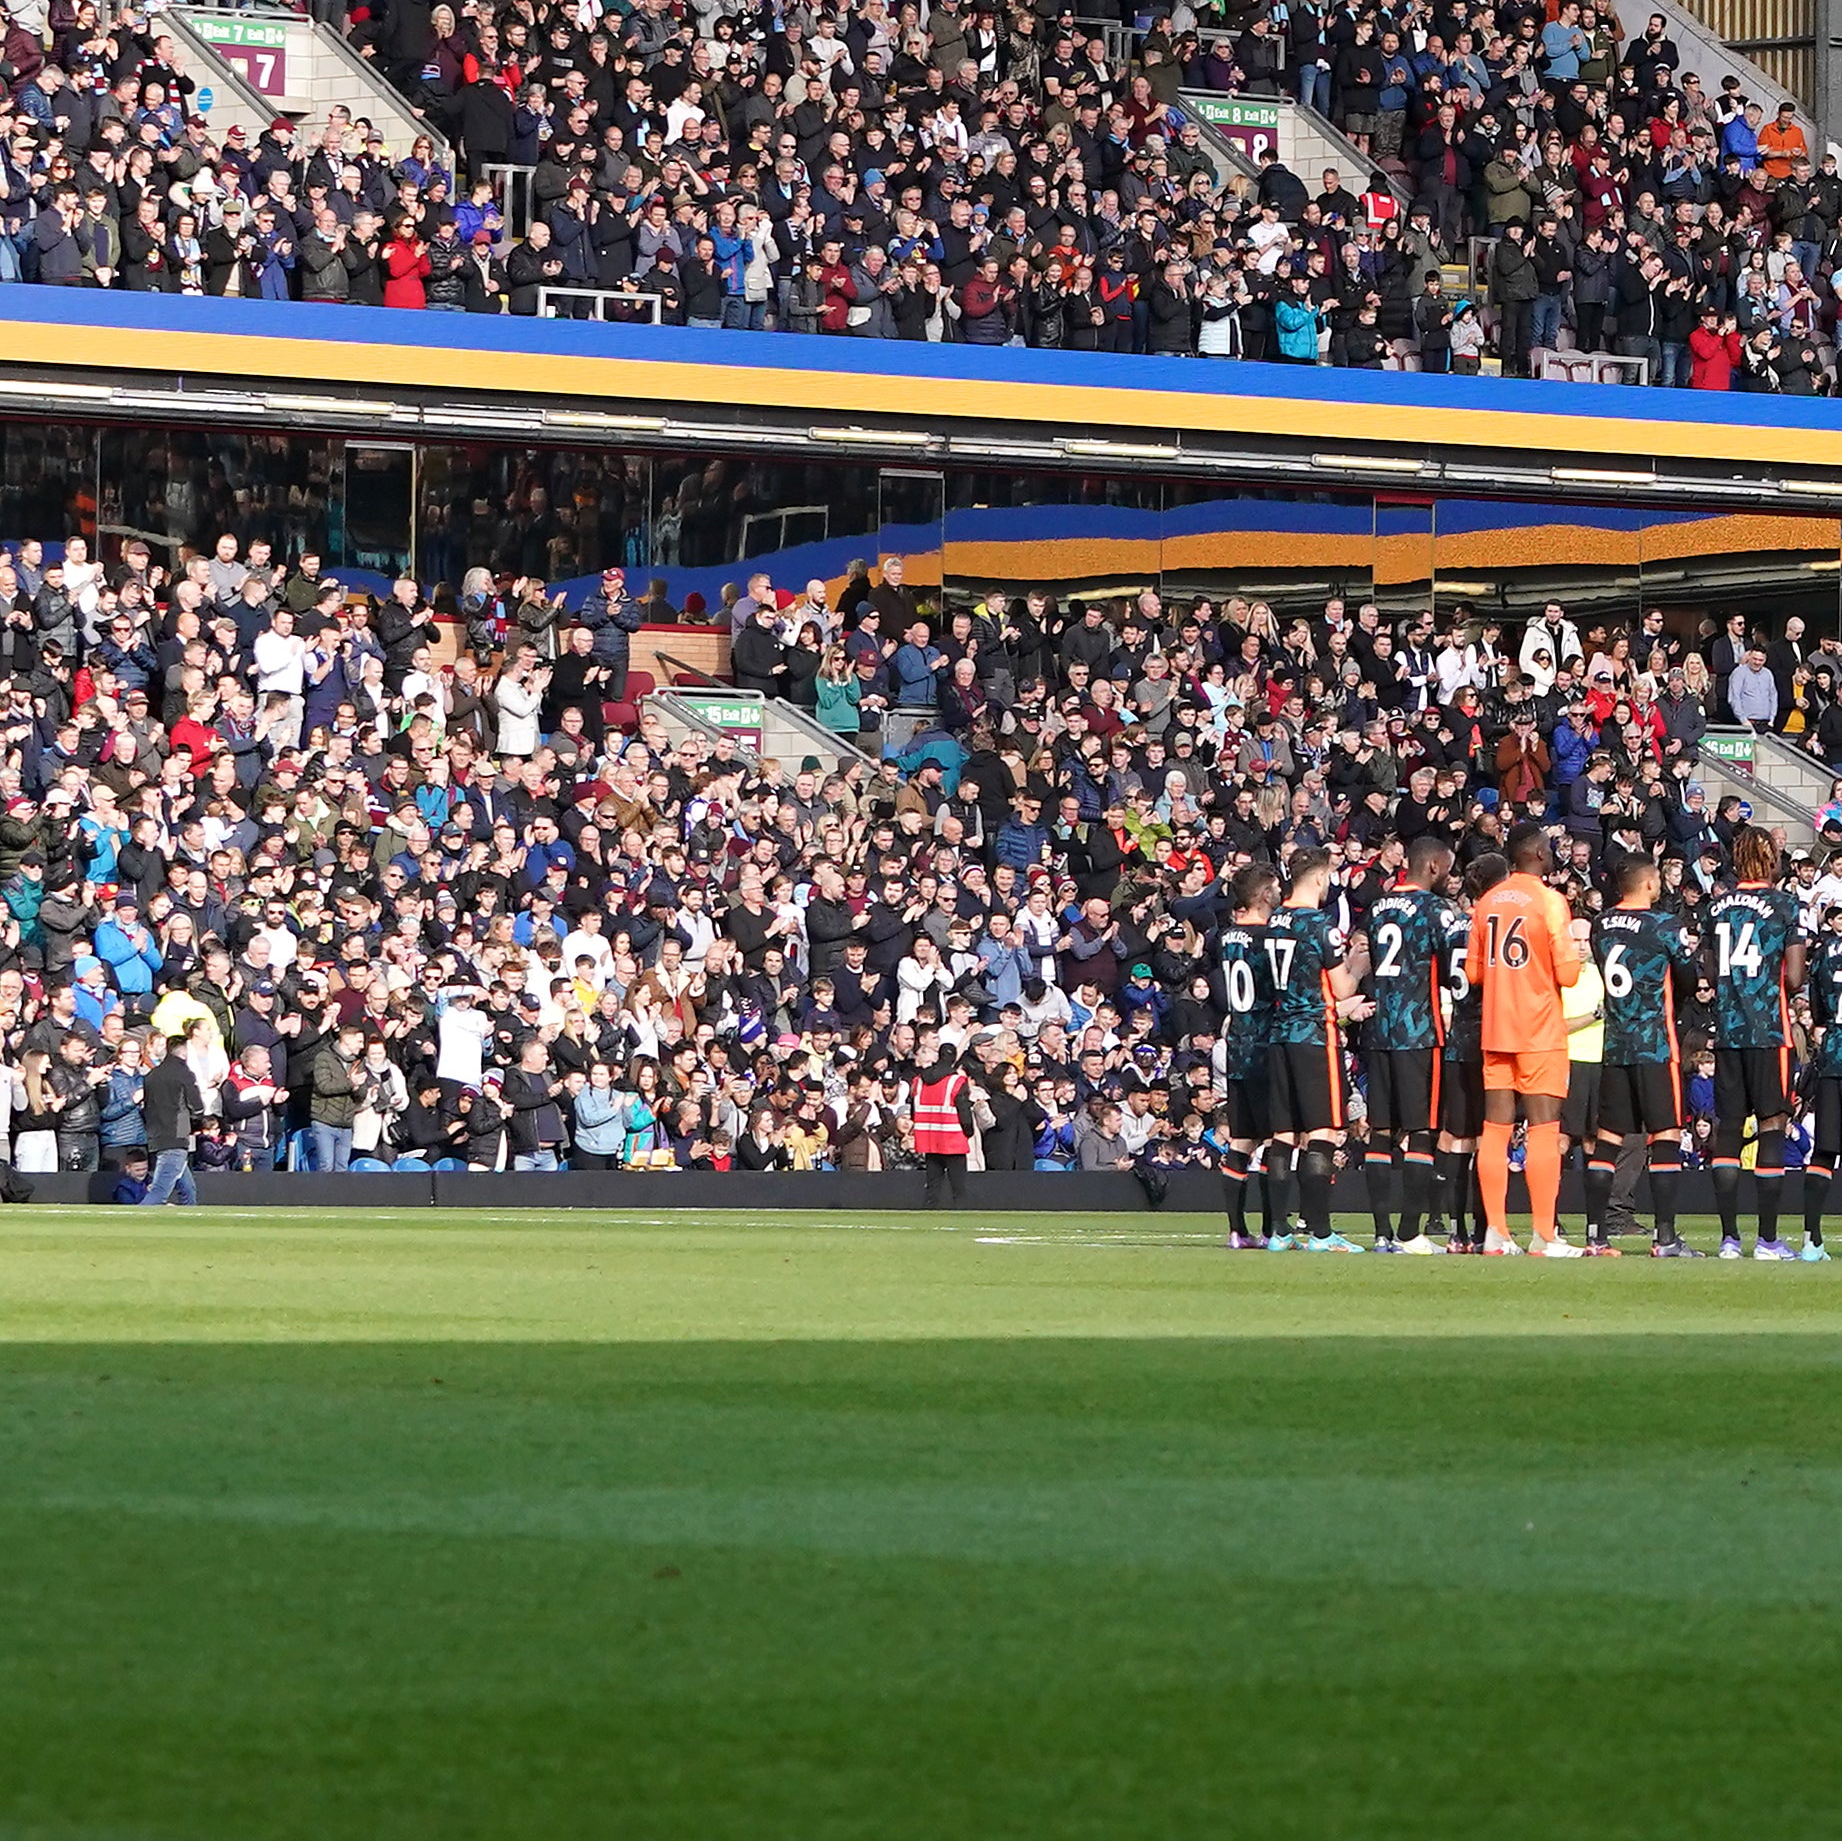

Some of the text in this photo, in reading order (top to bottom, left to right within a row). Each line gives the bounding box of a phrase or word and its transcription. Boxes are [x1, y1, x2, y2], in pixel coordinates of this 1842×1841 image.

[233, 25, 243, 42] 7
[256, 54, 275, 88] 7
[1232, 107, 1241, 123] 8
[1252, 133, 1268, 165] 8
[1601, 916, 1641, 934] T.SILVA
[1710, 894, 1774, 919] CHALOBAH
[1264, 938, 1297, 991] 17
[1375, 923, 1402, 977] 2
[1487, 914, 1530, 969] 16
[1715, 922, 1762, 977] 14
[1222, 960, 1256, 1013] 10
[1450, 948, 1469, 1001] 5
[1604, 944, 1633, 998] 6
